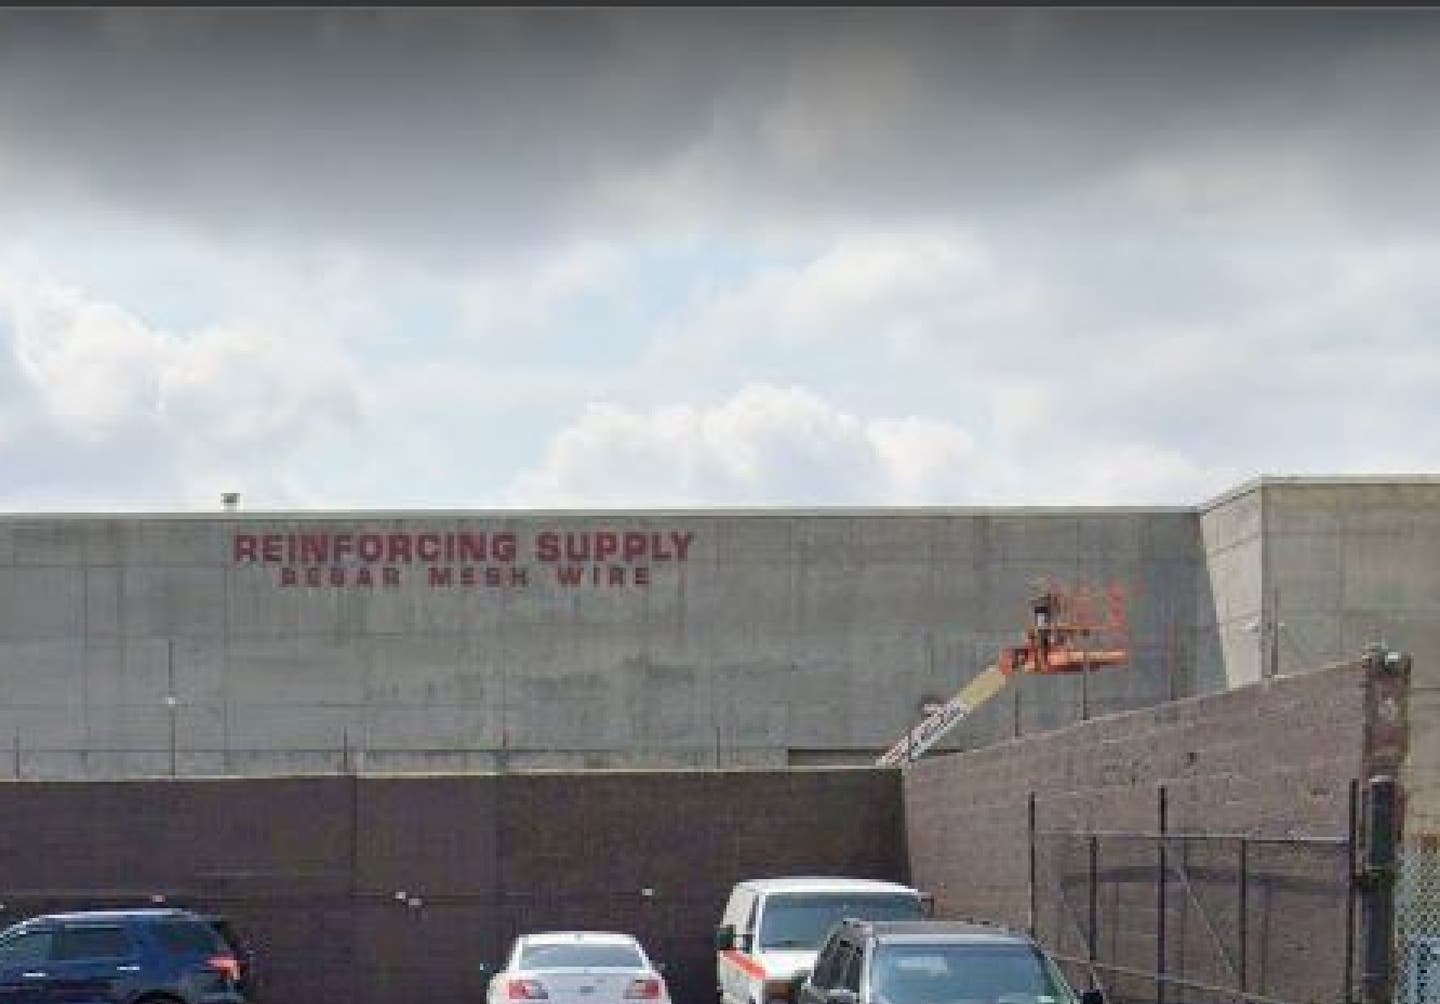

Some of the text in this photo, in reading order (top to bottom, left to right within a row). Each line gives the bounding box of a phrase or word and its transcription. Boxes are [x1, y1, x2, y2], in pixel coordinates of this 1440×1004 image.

[234, 532, 696, 564] REINFORCING SUPPLY
[280, 566, 653, 588] REBAR MESH WIRE
